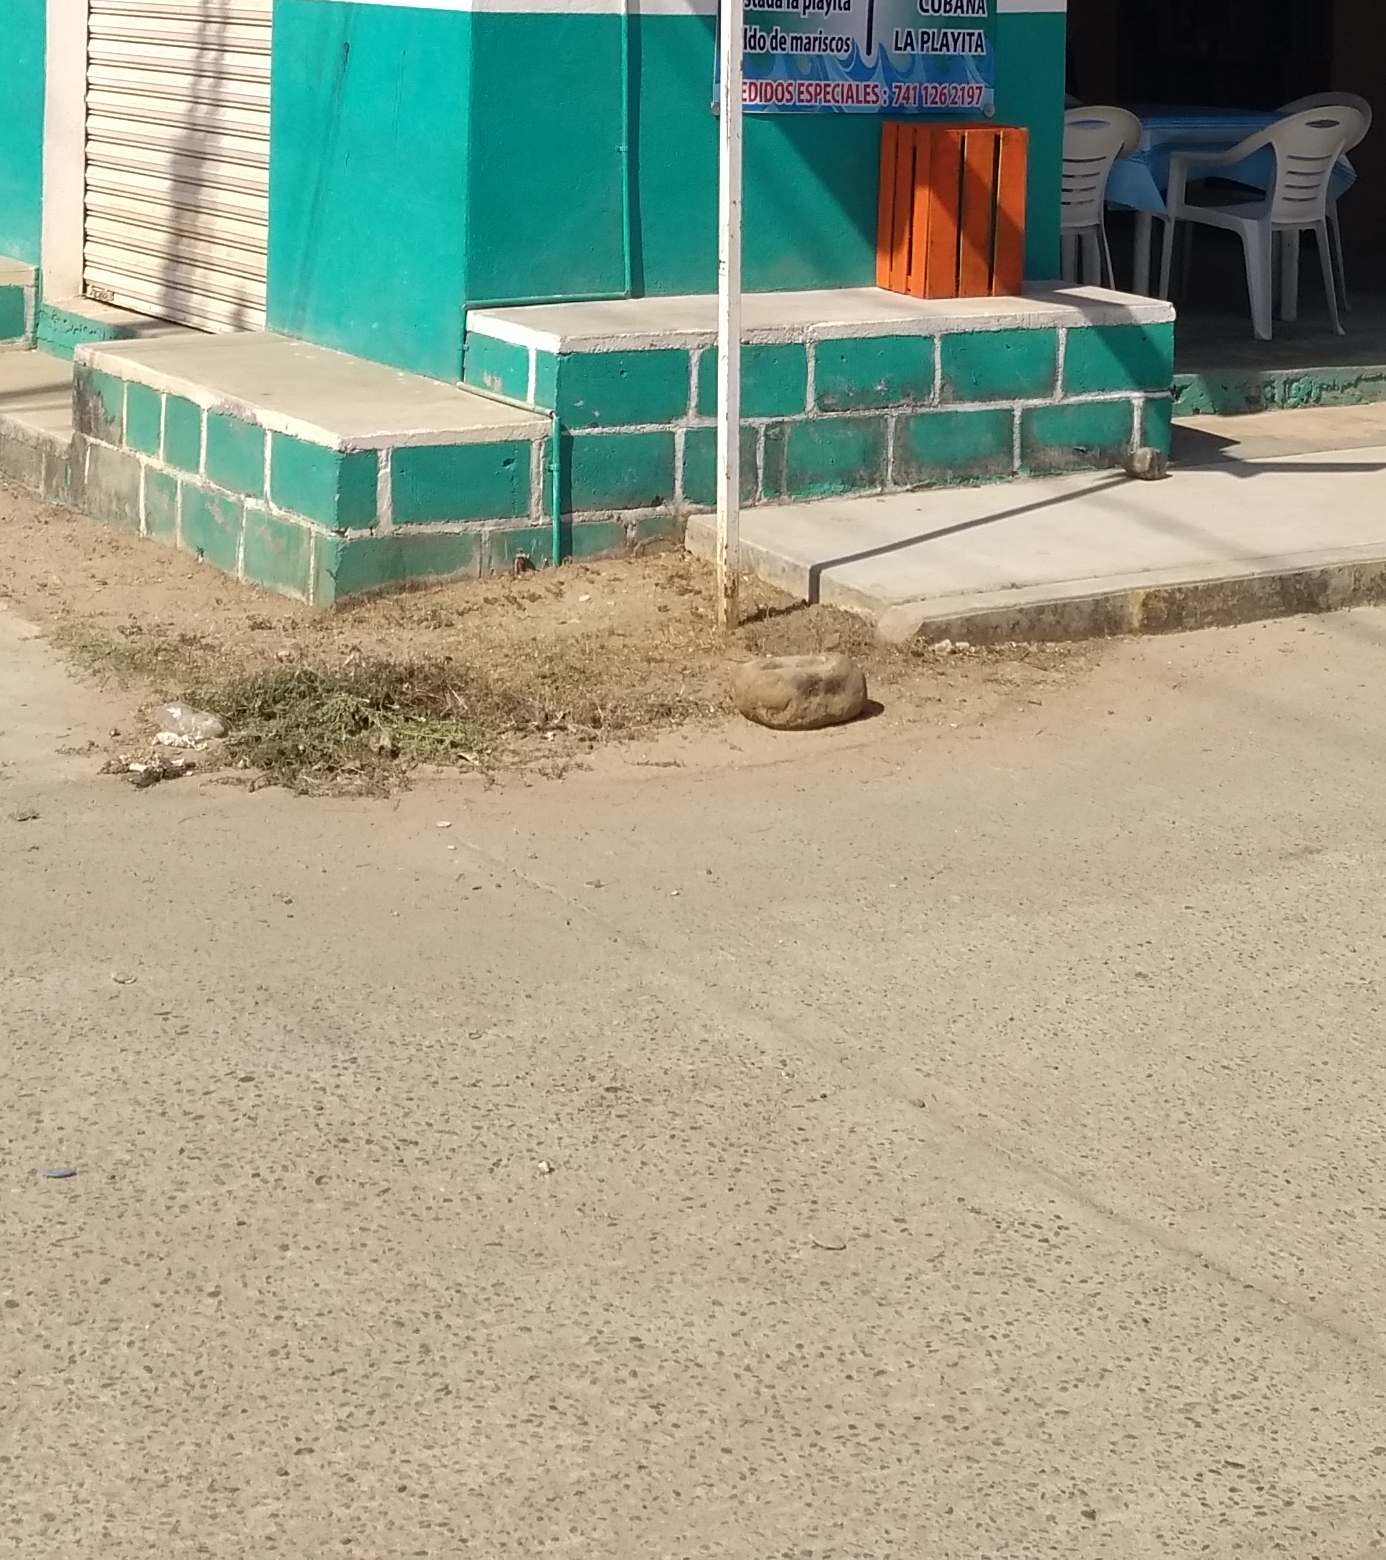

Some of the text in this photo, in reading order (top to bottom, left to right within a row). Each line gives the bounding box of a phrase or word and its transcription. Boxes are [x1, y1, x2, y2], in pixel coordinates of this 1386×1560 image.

[743, 27, 851, 53] ldo de mariscos
[894, 31, 985, 54] LA PLAYITA
[741, 81, 794, 103] EDIDOS
[797, 82, 880, 105] ESPECIALES
[891, 85, 920, 106] 741
[922, 86, 948, 107] 126
[949, 86, 984, 107] 2197
